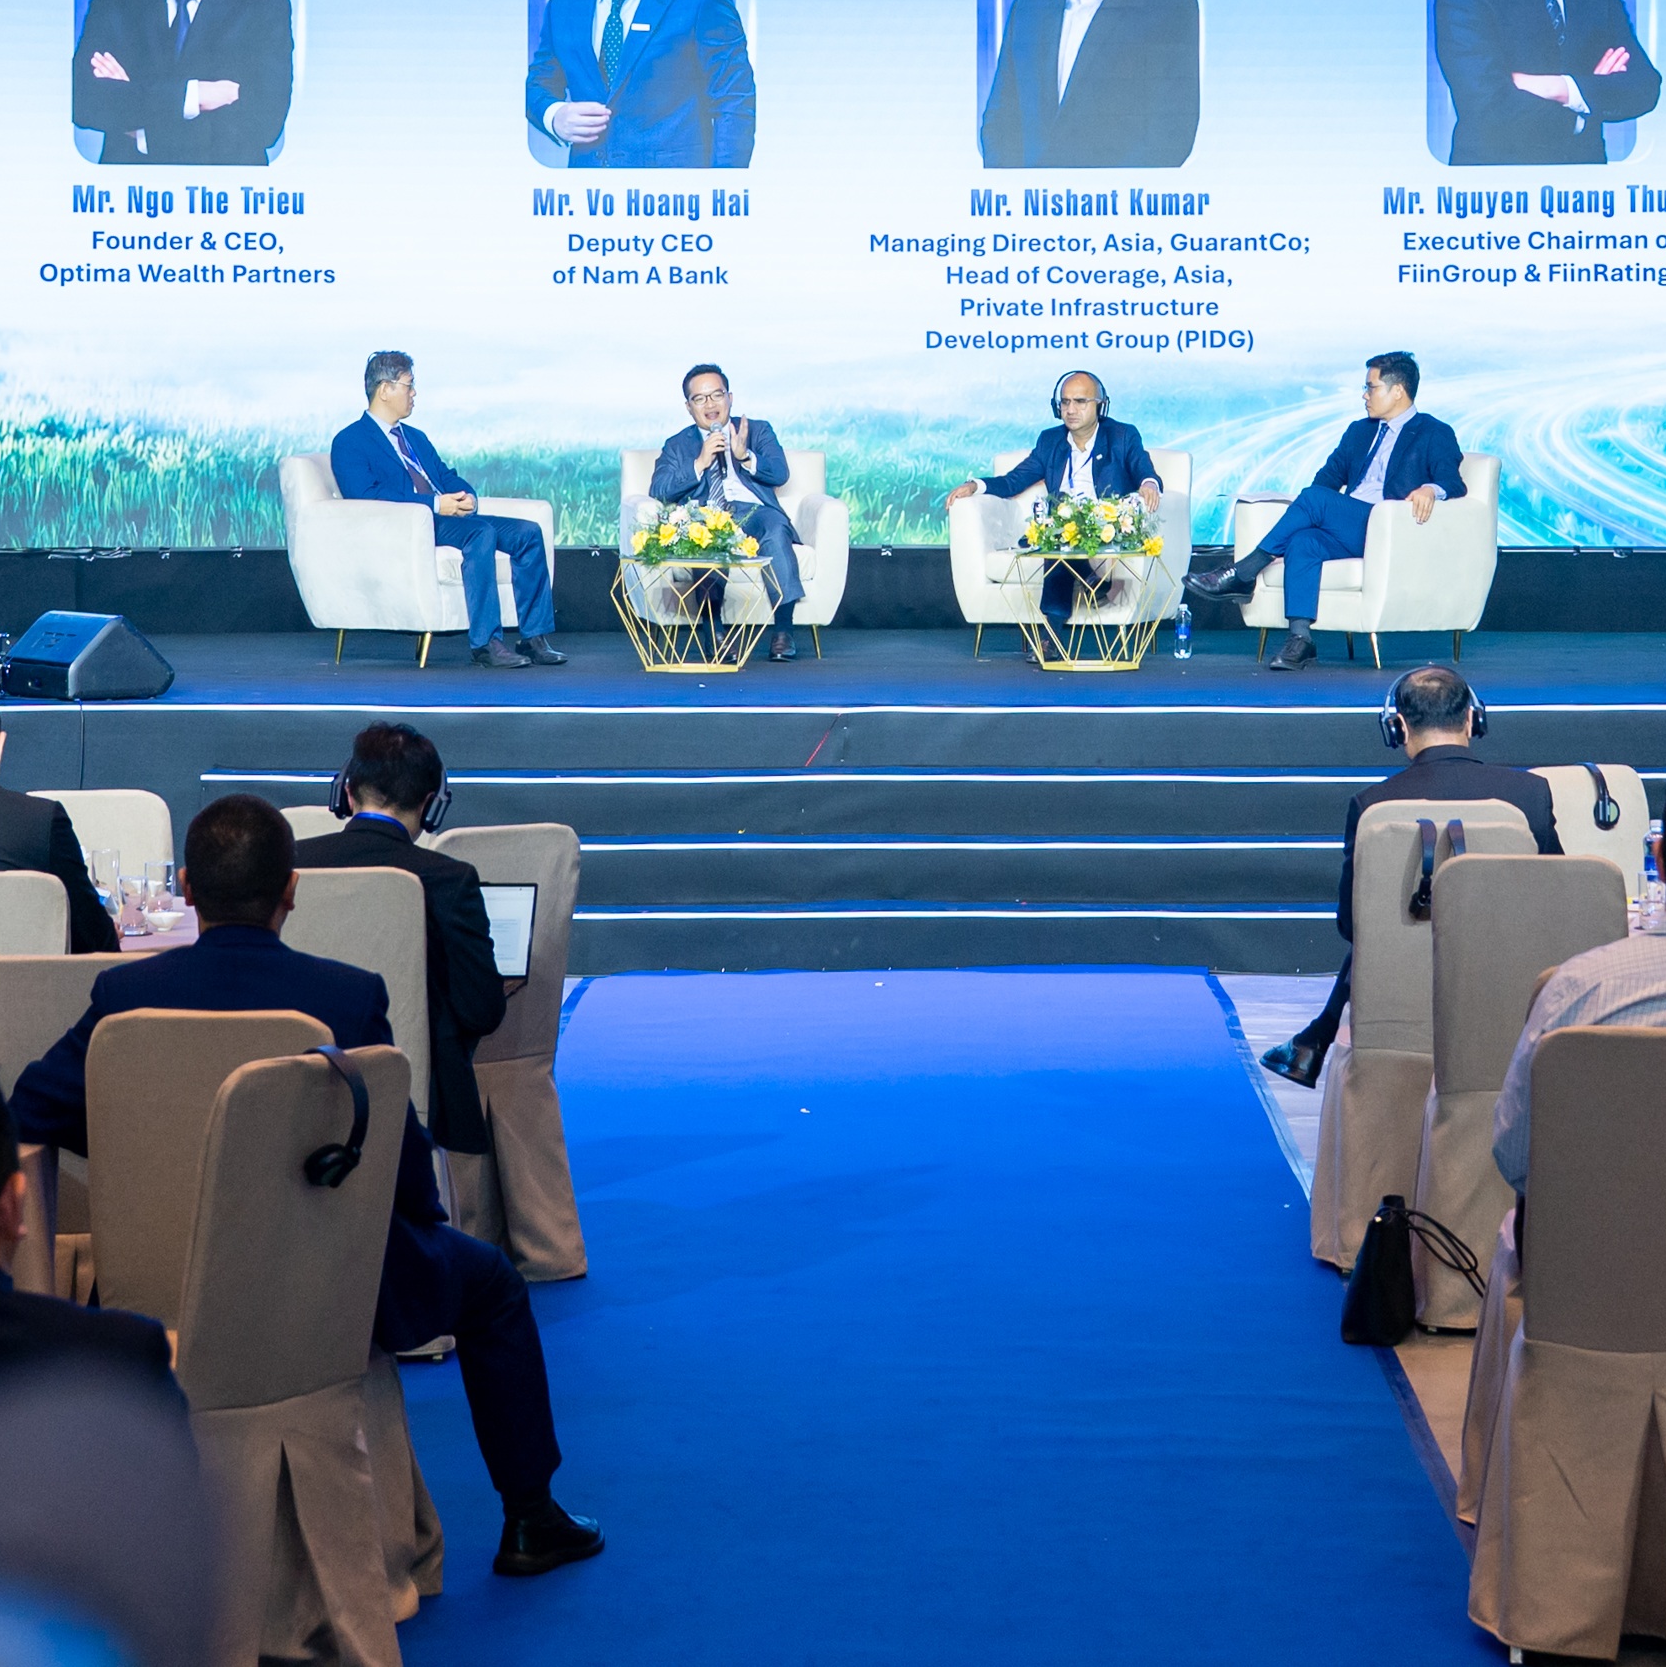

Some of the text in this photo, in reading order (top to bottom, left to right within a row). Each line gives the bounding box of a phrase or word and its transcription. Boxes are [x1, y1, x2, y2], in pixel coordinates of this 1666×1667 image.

[73, 185, 304, 218] Mr. Ngo The Trieu
[534, 189, 749, 221] Mr. Vo Hoang Hai
[971, 189, 1209, 216] Mr. Nishant Kumar
[1384, 187, 1424, 214] Mr.
[1438, 187, 1528, 219] Nguyen
[1541, 186, 1614, 218] Quang
[93, 231, 283, 254] Founder & CEO,
[569, 234, 713, 256] Deputy CEO
[871, 233, 1309, 256] Managing Director, Asia, GuarantCo;
[1404, 231, 1520, 250] Executive
[1528, 231, 1647, 249] Chairman
[40, 263, 335, 286] Optima Wealth Partners
[553, 266, 728, 284] of Nam A Bank
[947, 265, 1232, 288] Head of Coverage, Asia,
[1399, 264, 1516, 287] FiinGroup
[1525, 264, 1540, 282] &
[961, 298, 1218, 316] Private Infrastructure
[925, 330, 1253, 353] Development Group (PIDG)
